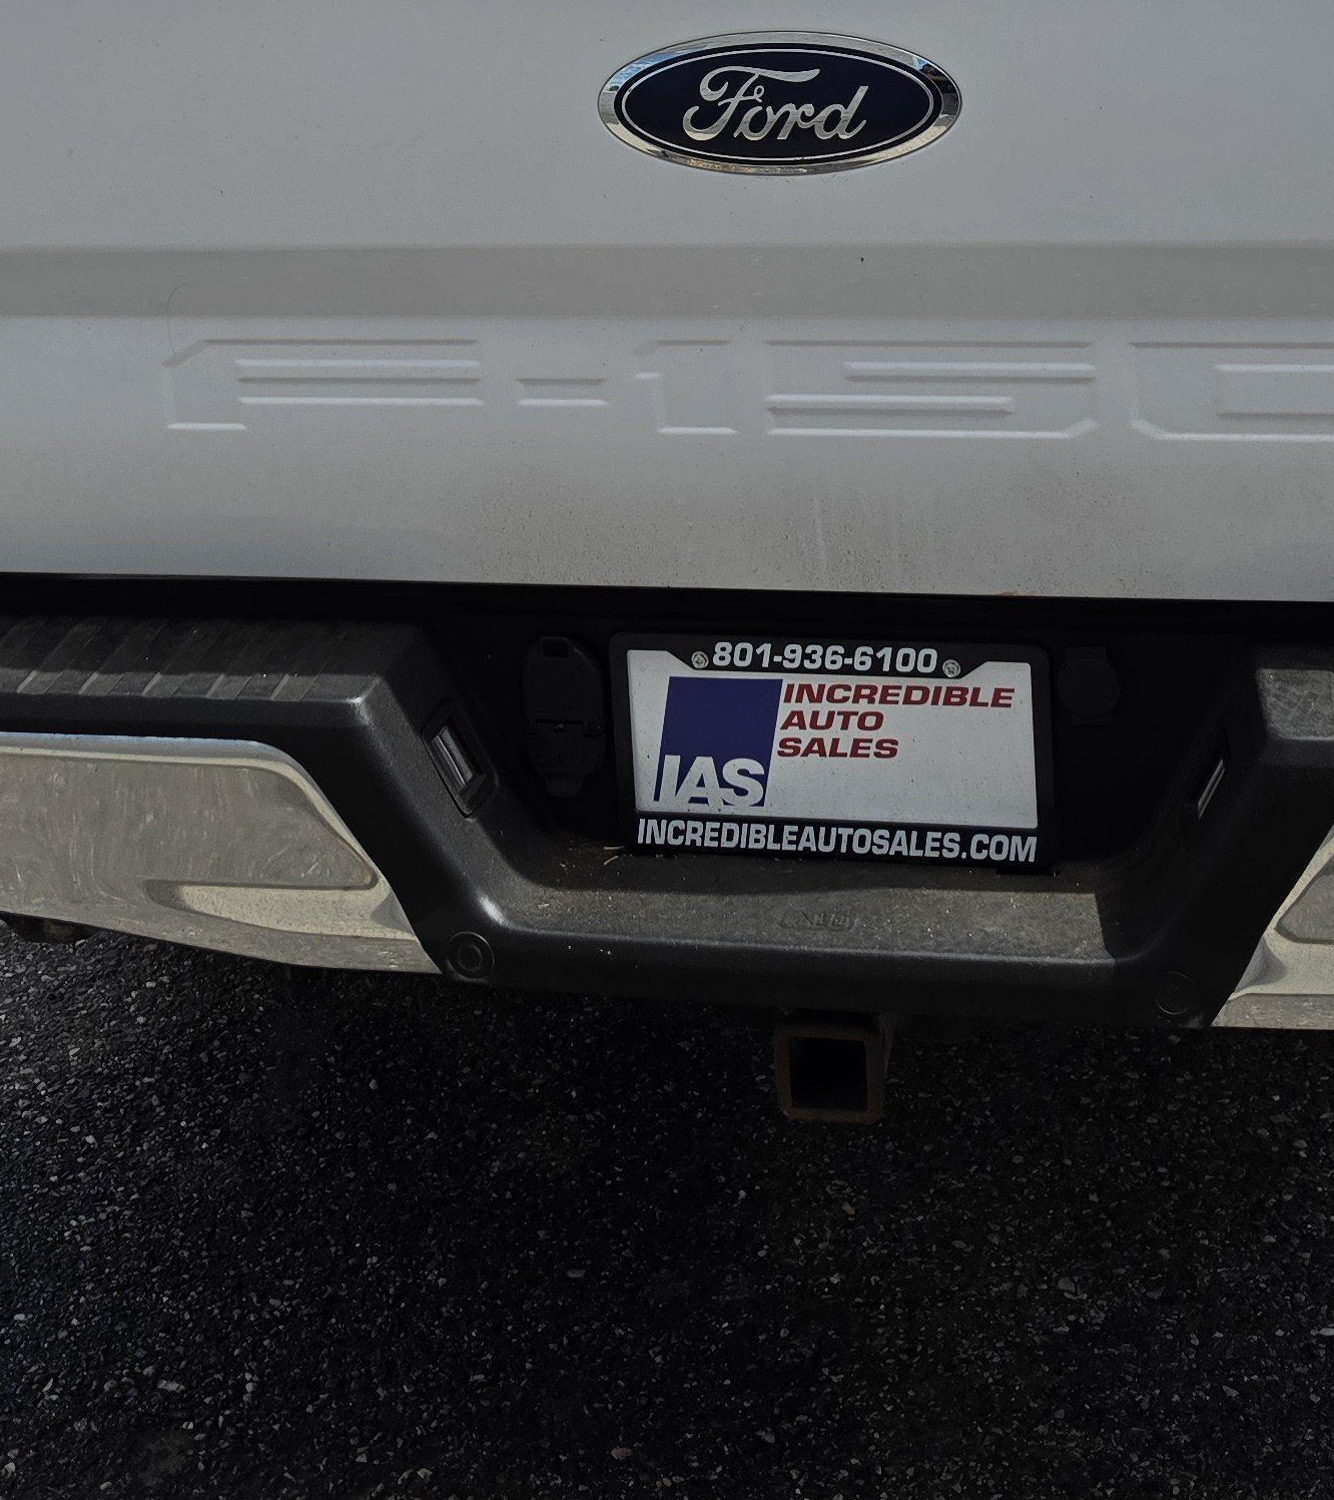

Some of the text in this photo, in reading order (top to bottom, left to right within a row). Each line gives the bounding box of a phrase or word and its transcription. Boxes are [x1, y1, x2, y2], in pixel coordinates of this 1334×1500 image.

[682, 65, 869, 141] Ford
[712, 641, 938, 675] 801-936-6100
[782, 683, 1015, 708] INCREDIBLE
[779, 710, 884, 731] AUTO
[776, 737, 899, 759] SALES
[659, 754, 765, 808] IAS
[637, 818, 1037, 863] INCREDIBLEAUTOSALES.COM
